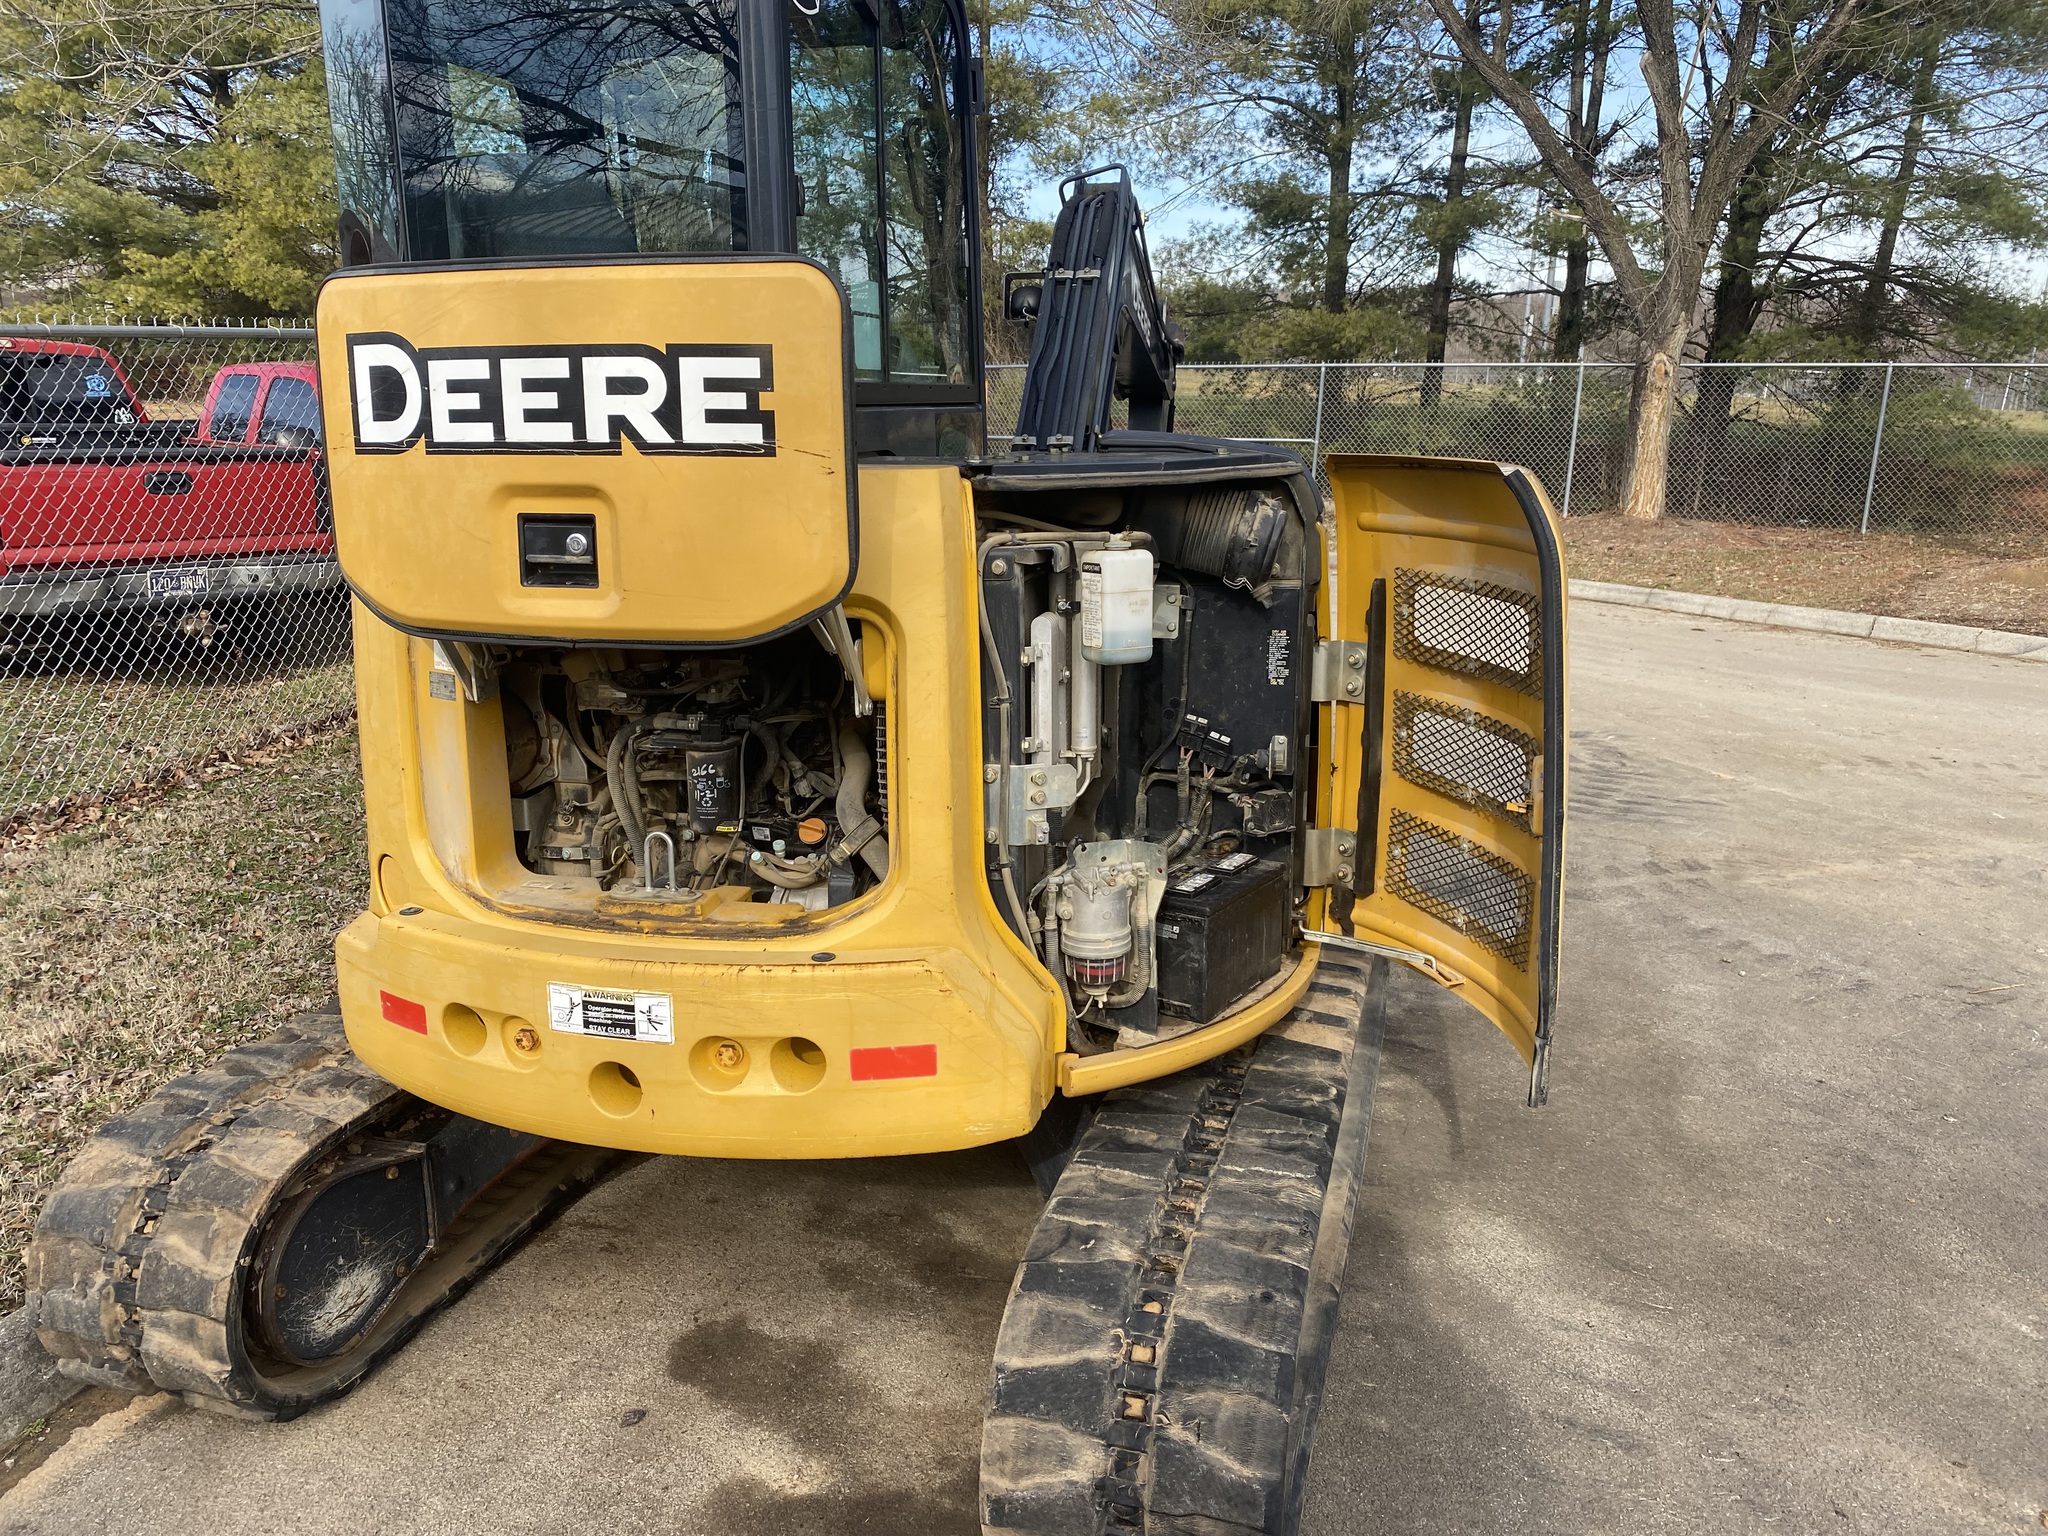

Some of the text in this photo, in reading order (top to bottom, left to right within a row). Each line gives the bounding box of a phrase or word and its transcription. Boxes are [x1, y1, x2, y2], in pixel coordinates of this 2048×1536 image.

[353, 342, 765, 446] DEERE
[692, 764, 716, 777] 2166
[591, 991, 633, 1002] WARNING
[587, 1004, 611, 1013] Operator
[589, 1024, 631, 1035] STAY CLEAR
